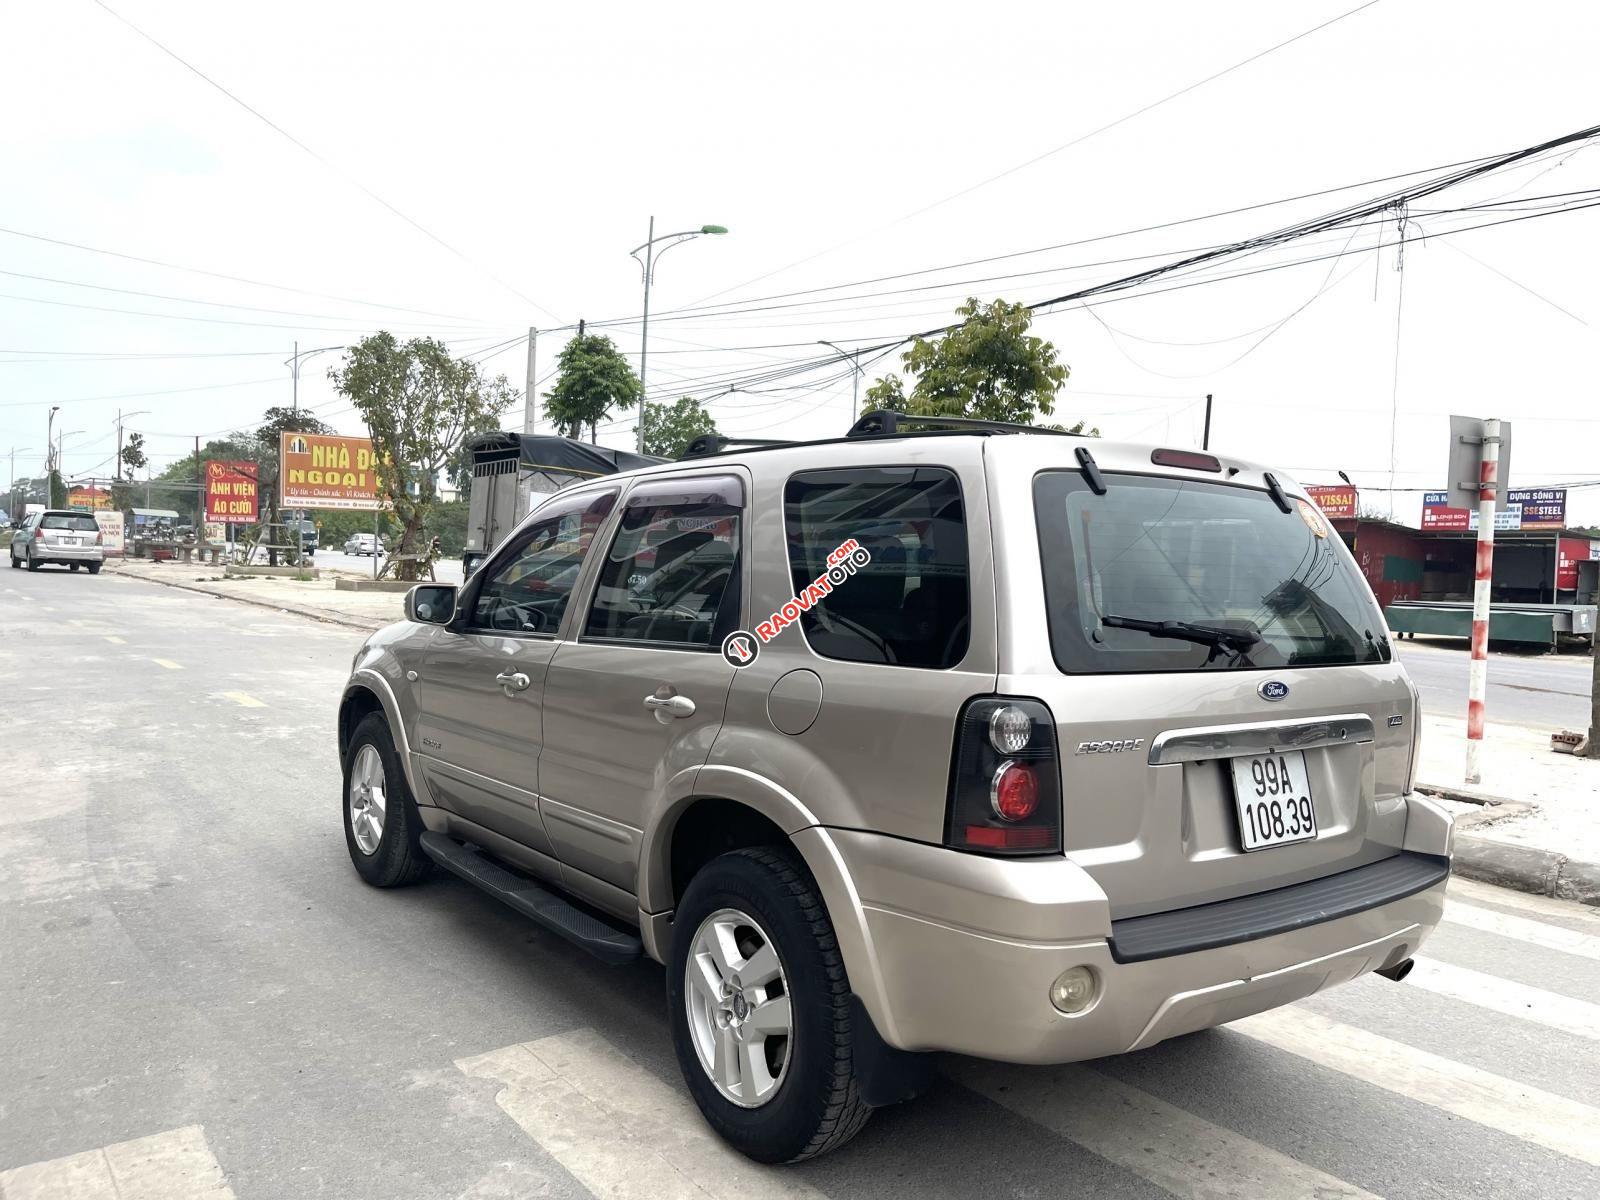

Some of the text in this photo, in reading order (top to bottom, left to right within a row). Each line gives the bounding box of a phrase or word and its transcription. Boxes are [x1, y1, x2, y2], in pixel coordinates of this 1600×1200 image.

[312, 442, 350, 469] NHÀ
[210, 478, 255, 499] ẢNH VIỆN
[289, 469, 366, 489] NGOẠI
[213, 497, 227, 514] ÁO
[1320, 494, 1353, 506] VISSAI
[1267, 683, 1285, 696] Ford
[1075, 738, 1145, 755] ESCAPE
[1251, 756, 1293, 797] 99A
[1246, 796, 1313, 843] 108.39
